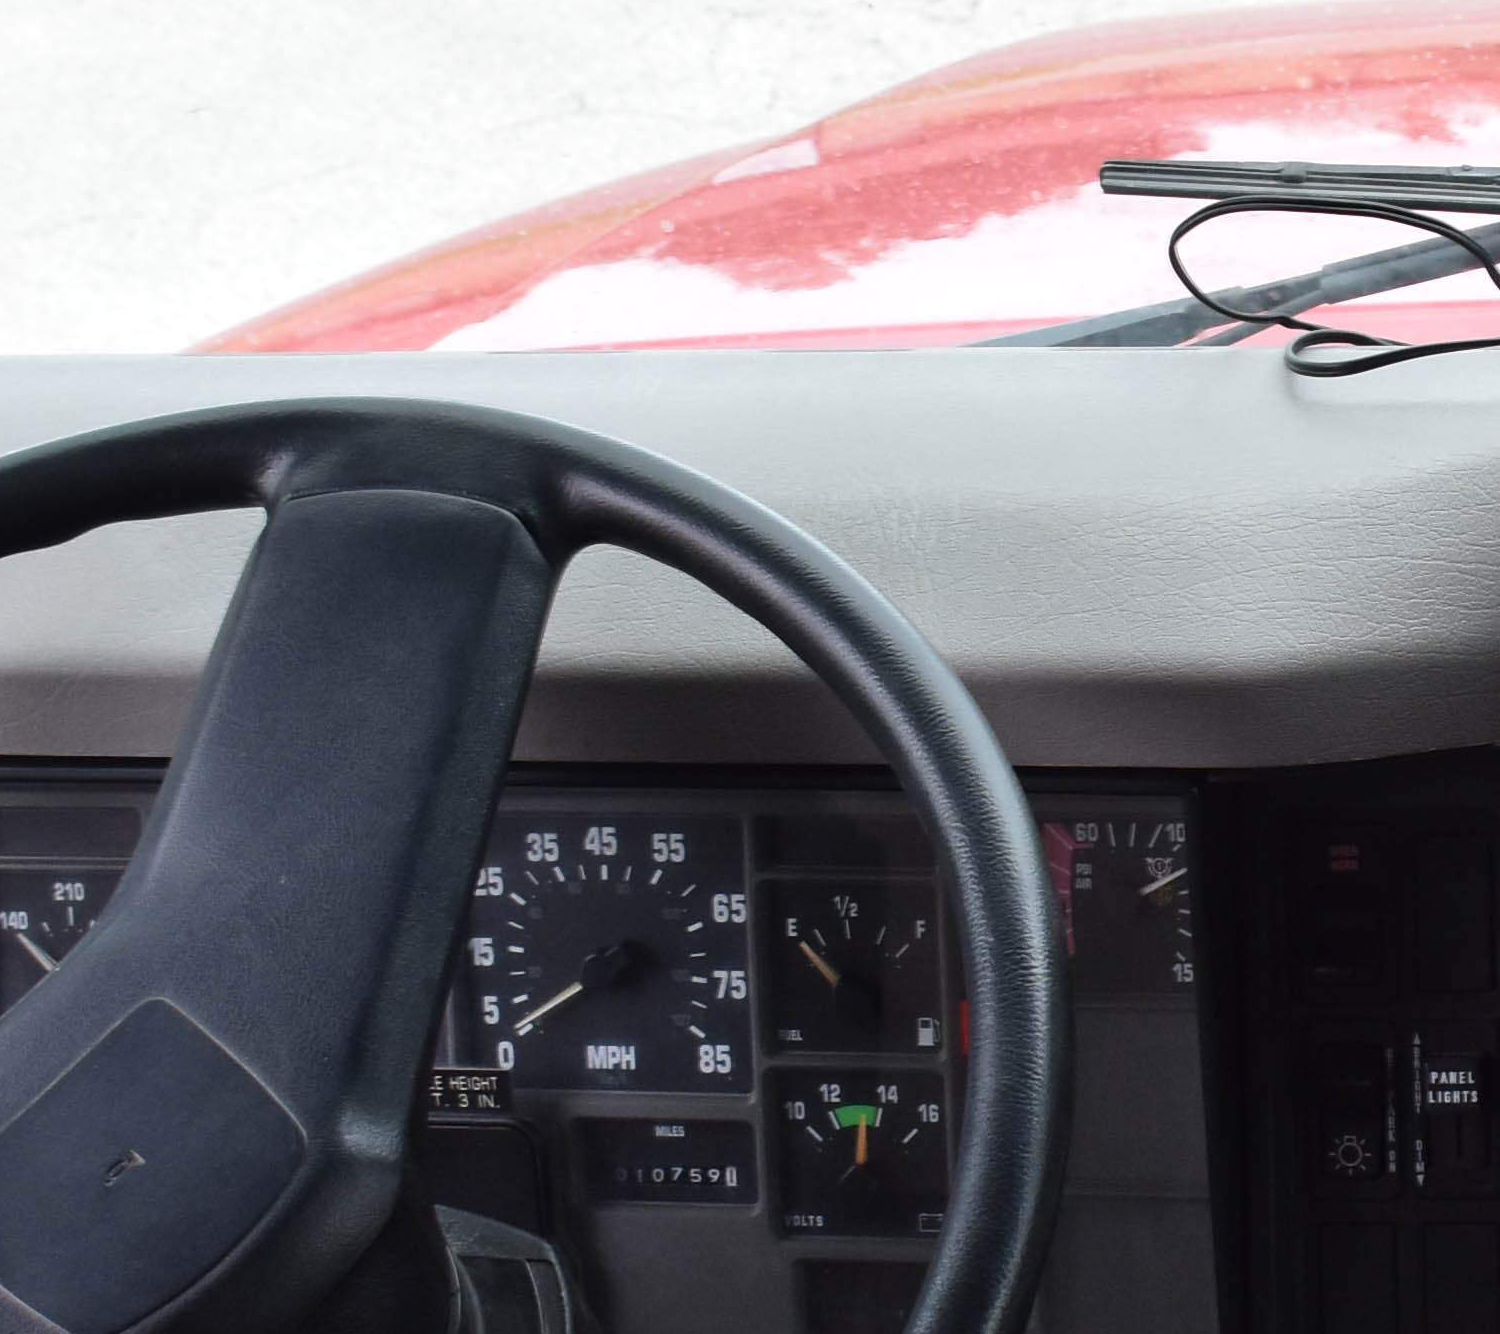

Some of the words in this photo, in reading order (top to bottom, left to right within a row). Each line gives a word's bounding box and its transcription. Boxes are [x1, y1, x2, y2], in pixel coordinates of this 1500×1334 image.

[584, 826, 618, 856] 45
[1075, 823, 1099, 842] 60
[526, 832, 559, 862] 35
[652, 833, 685, 863] 55
[53, 882, 85, 901] 210
[712, 894, 747, 923] 65
[787, 918, 798, 937] E
[916, 920, 927, 939] F
[468, 937, 494, 966] 15
[1172, 963, 1194, 983] 15
[713, 970, 747, 999] 75
[483, 995, 500, 1024] 5
[498, 1041, 515, 1070] 0
[587, 1045, 636, 1070] MPH
[699, 1045, 732, 1074] 85
[449, 1076, 498, 1091] HEIGHT
[1430, 1071, 1475, 1084] PANEL
[458, 1094, 469, 1107] 3
[477, 1095, 500, 1109] IN.
[818, 1084, 841, 1103] 12
[876, 1085, 899, 1104] 14
[1428, 1090, 1479, 1104] LIGHTS
[784, 1101, 805, 1121] 10
[917, 1104, 940, 1123] 16
[655, 1125, 685, 1137] MILES
